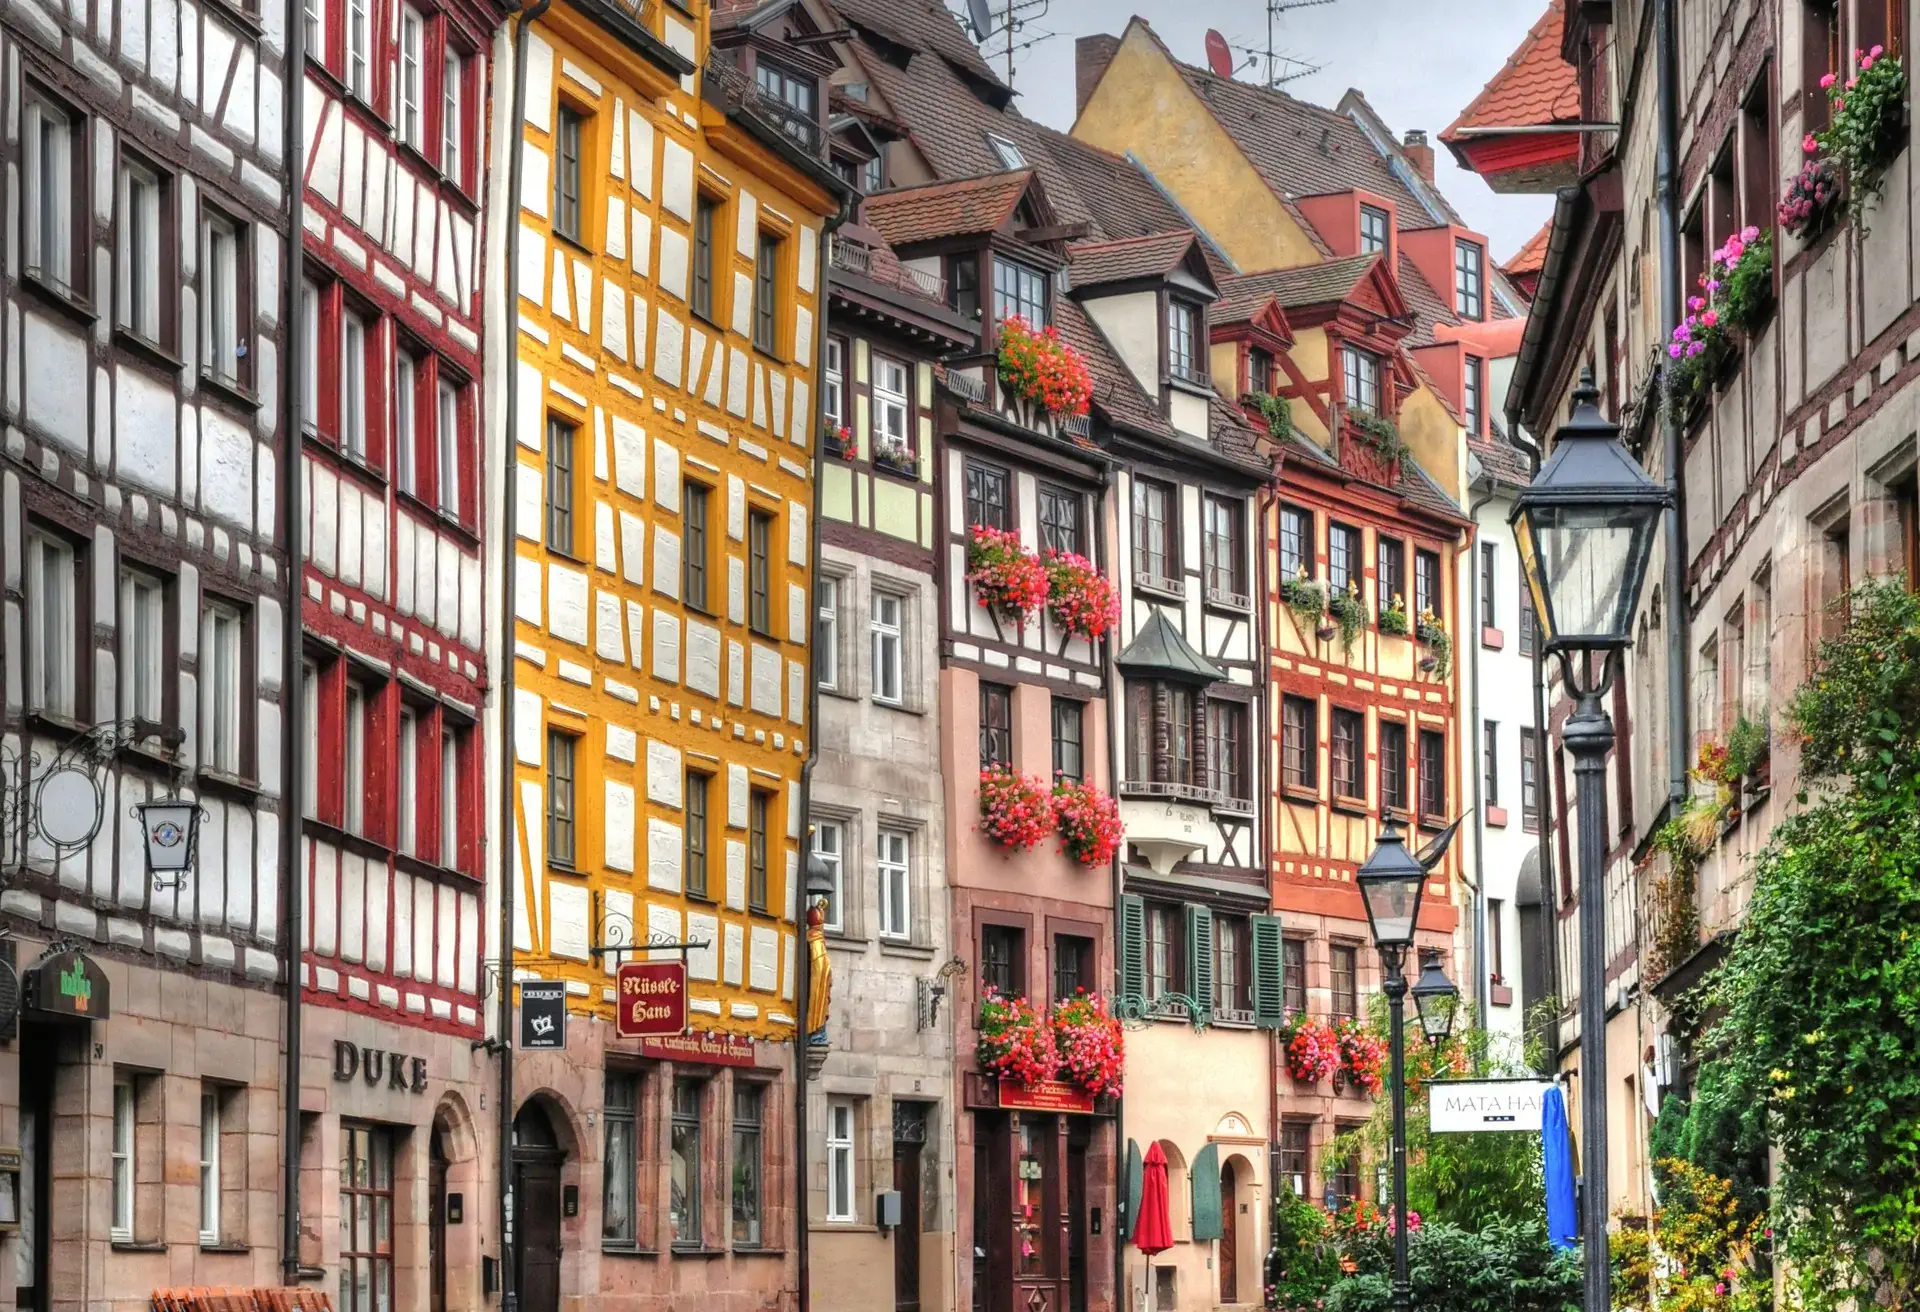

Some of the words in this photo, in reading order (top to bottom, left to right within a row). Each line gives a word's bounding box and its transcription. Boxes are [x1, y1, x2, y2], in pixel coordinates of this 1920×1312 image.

[333, 1039, 429, 1095] DUKE
[1445, 1096, 1502, 1112] MATA
[1508, 1095, 1543, 1111] HA
